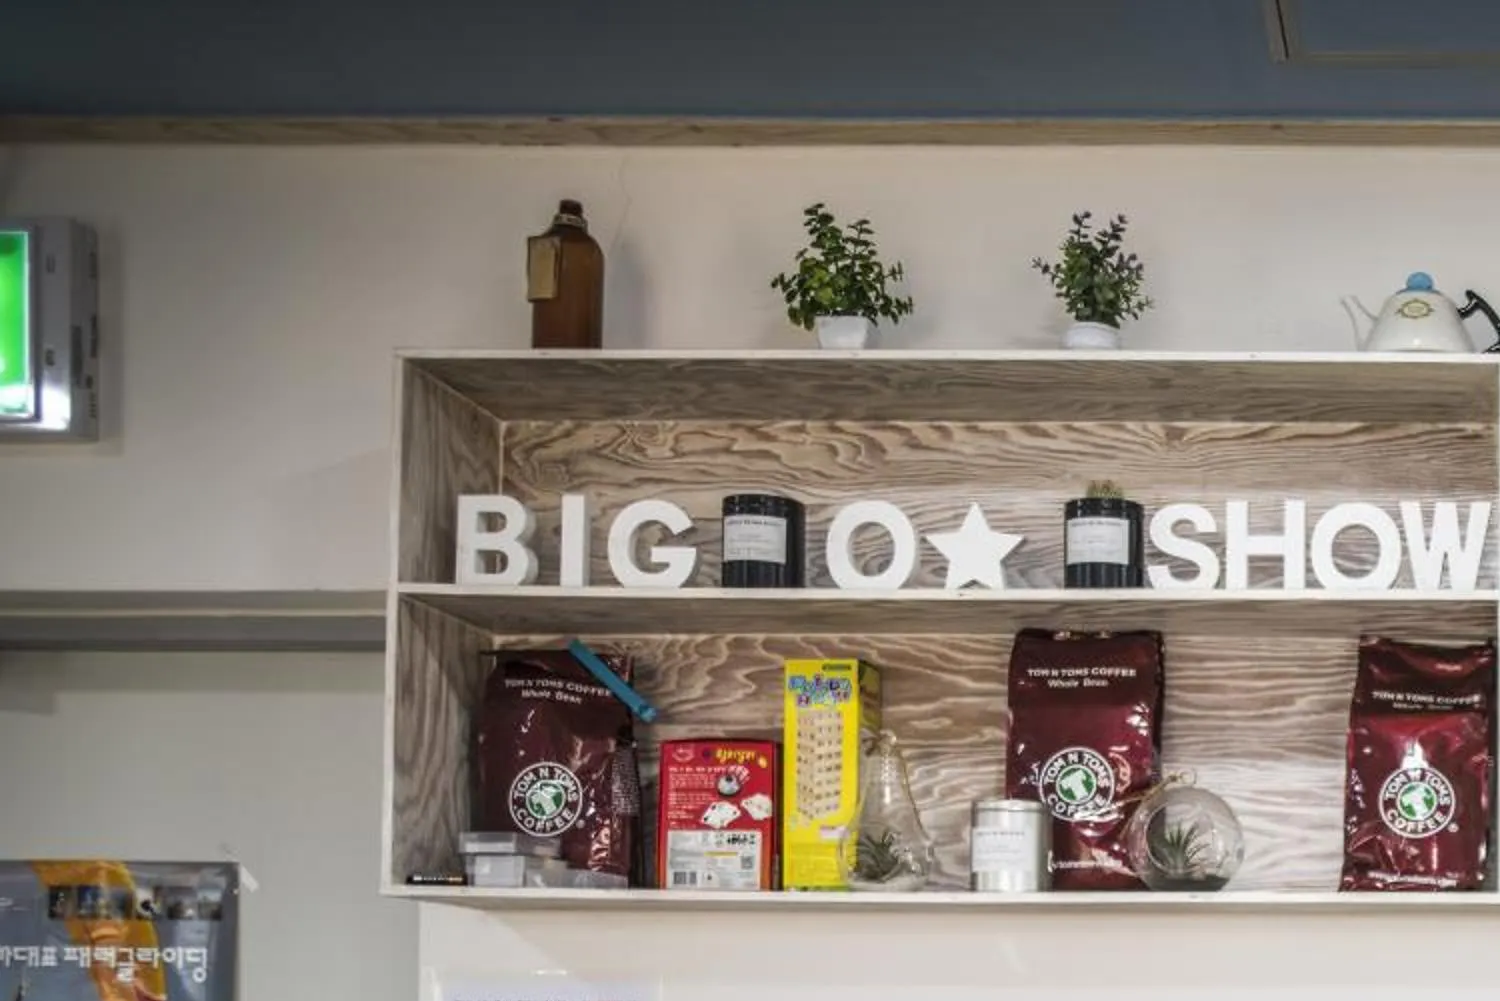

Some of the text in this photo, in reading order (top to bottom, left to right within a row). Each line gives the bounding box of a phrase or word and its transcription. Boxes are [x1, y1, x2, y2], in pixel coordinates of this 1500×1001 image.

[456, 493, 698, 589] BIG
[1147, 499, 1492, 590] SHOW
[1027, 668, 1050, 678] TOM
[1061, 668, 1090, 677] TOMS
[1091, 667, 1137, 677] COFFEE
[514, 769, 537, 799] TOM
[539, 767, 550, 778] N
[1045, 752, 1110, 787] TOM N TOMS
[515, 807, 575, 833] COFFEE
[1387, 810, 1447, 834] COFFEE
